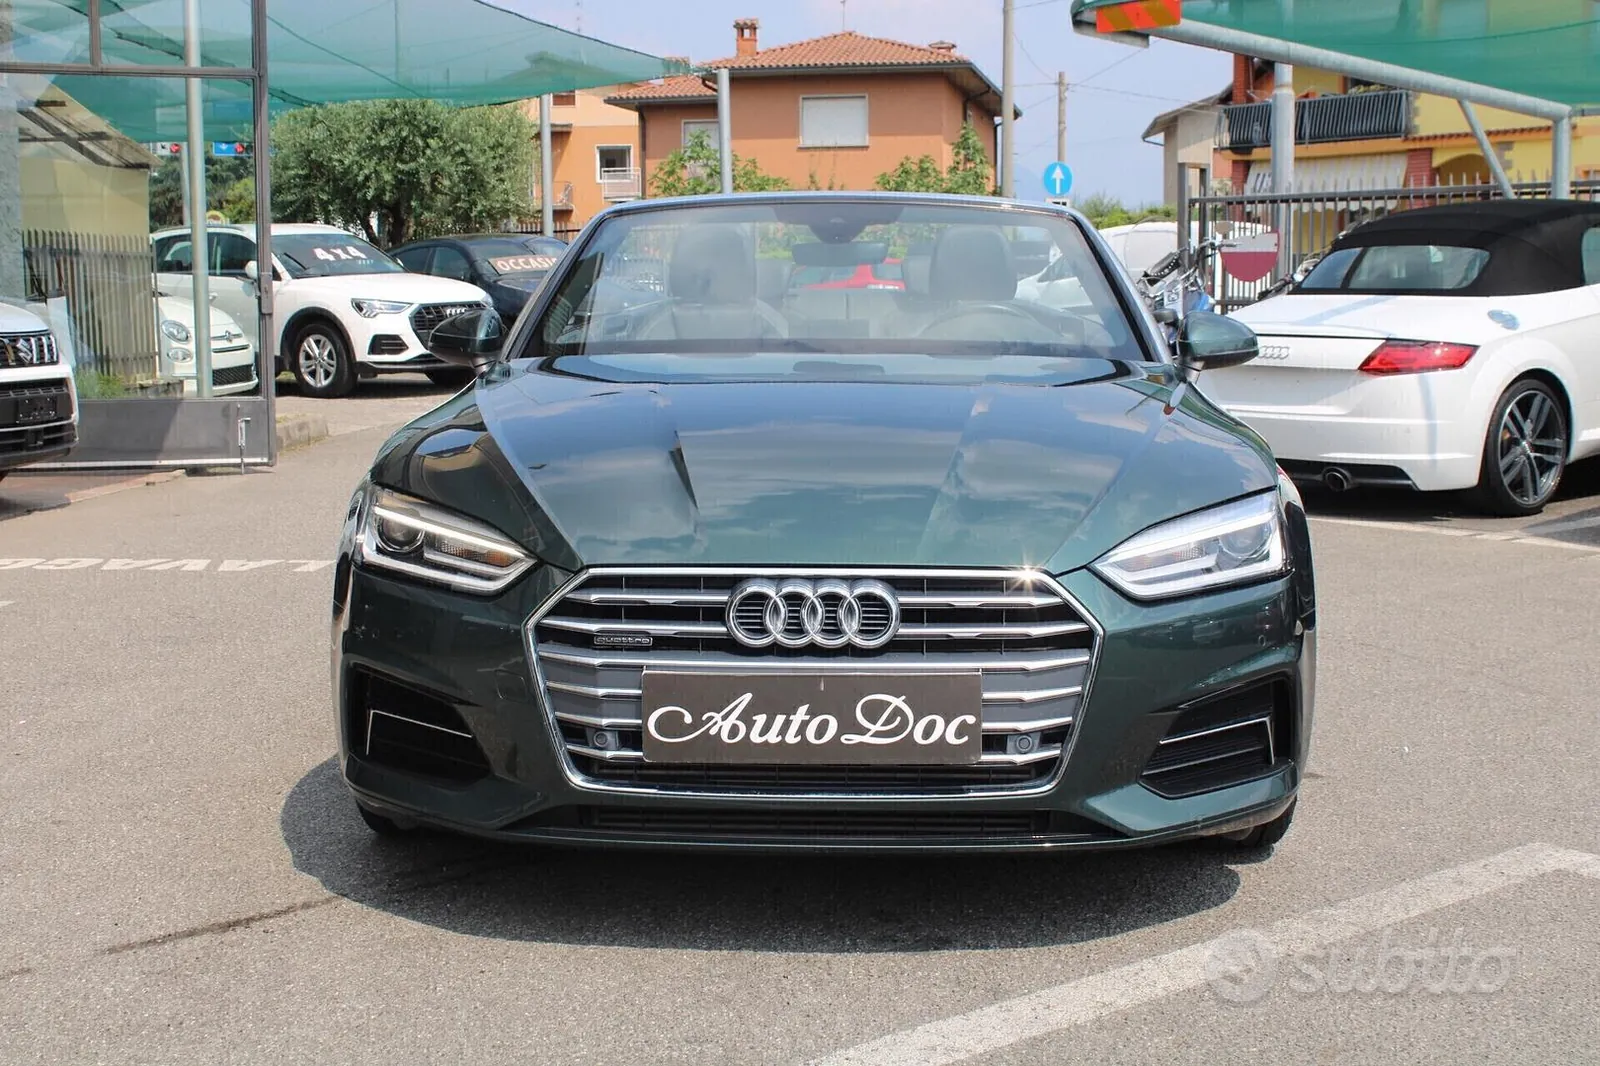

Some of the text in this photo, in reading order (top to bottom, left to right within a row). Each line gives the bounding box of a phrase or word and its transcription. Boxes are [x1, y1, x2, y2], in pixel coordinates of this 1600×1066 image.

[496, 257, 557, 271] OCCASI
[596, 636, 650, 644] quattro
[647, 692, 976, 745] Auto Doc
